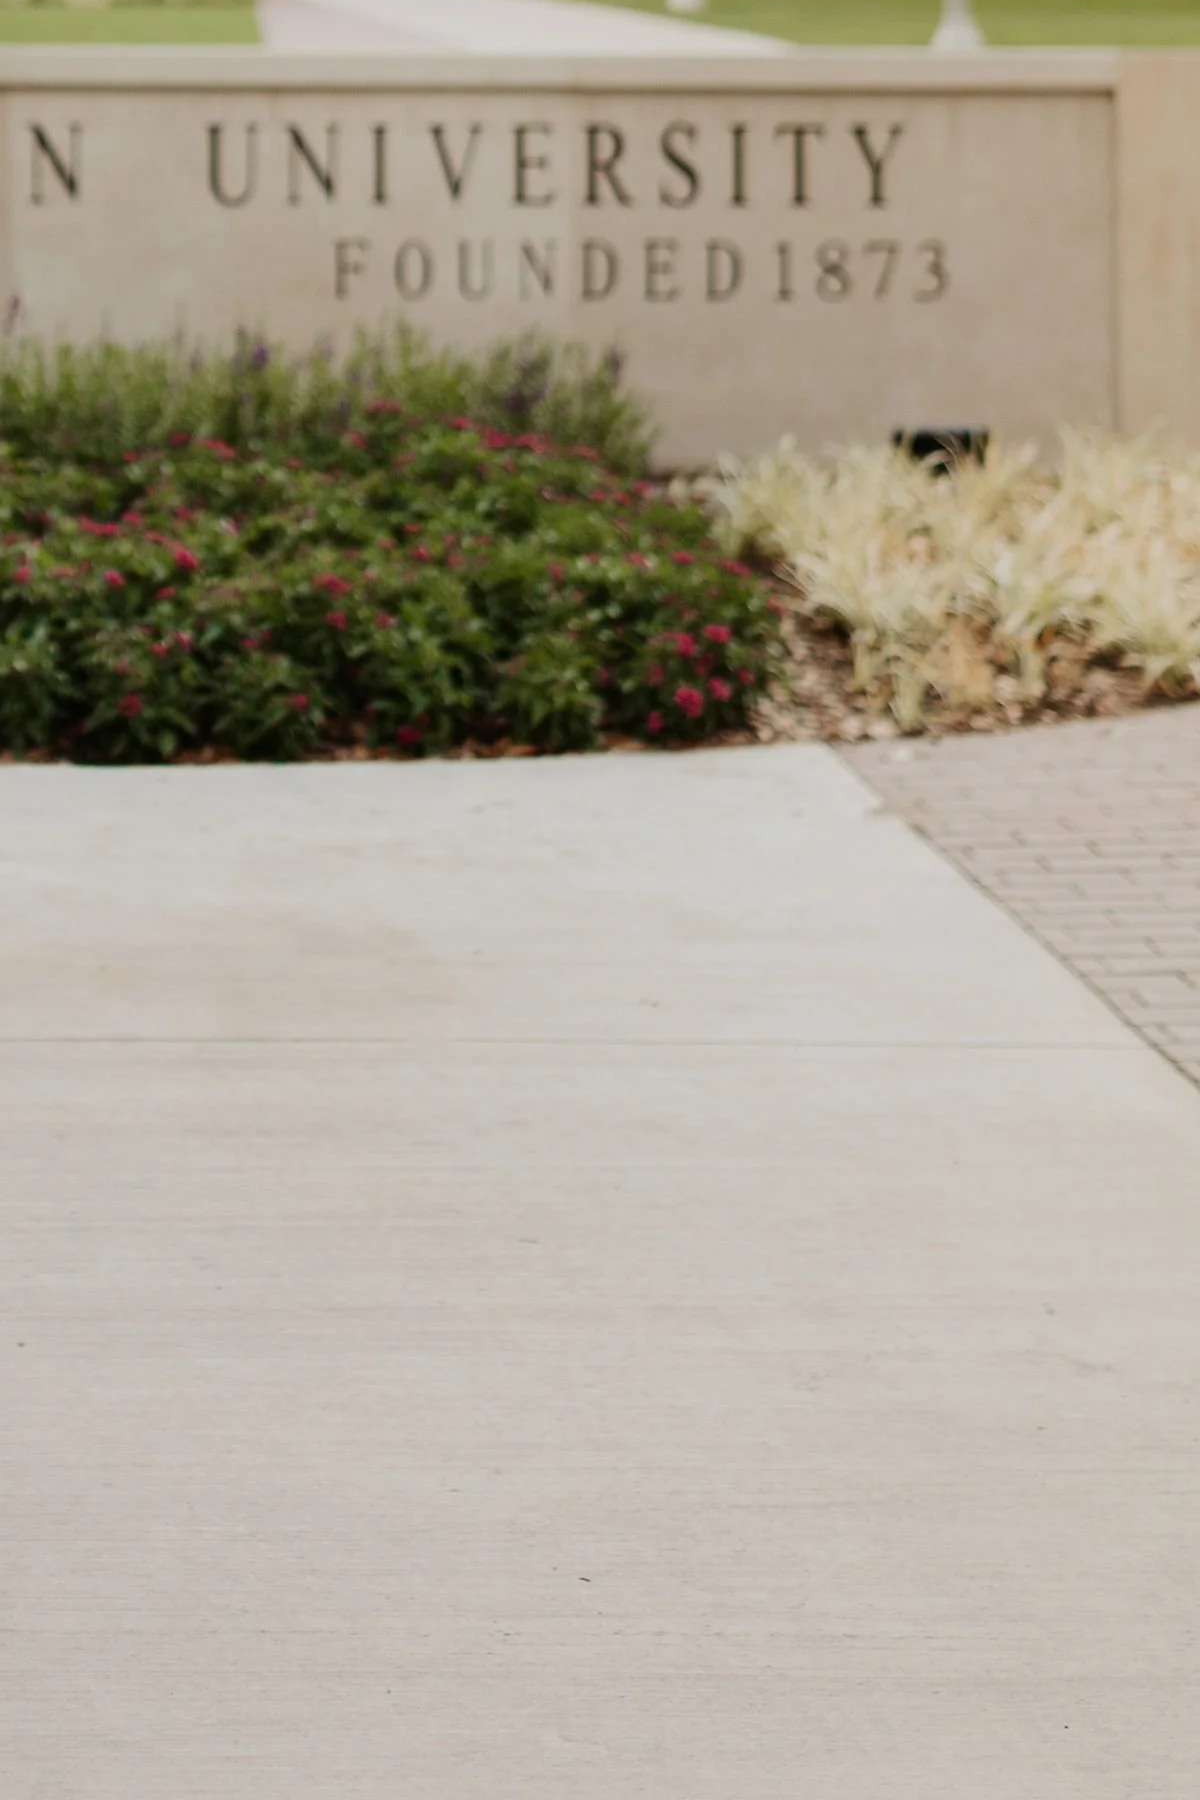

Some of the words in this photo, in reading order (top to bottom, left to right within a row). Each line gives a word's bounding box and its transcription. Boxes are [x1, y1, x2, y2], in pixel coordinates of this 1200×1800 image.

[205, 121, 906, 208] UNIVERSITY
[334, 236, 746, 302] FOUNDED
[774, 236, 952, 304] 1873
